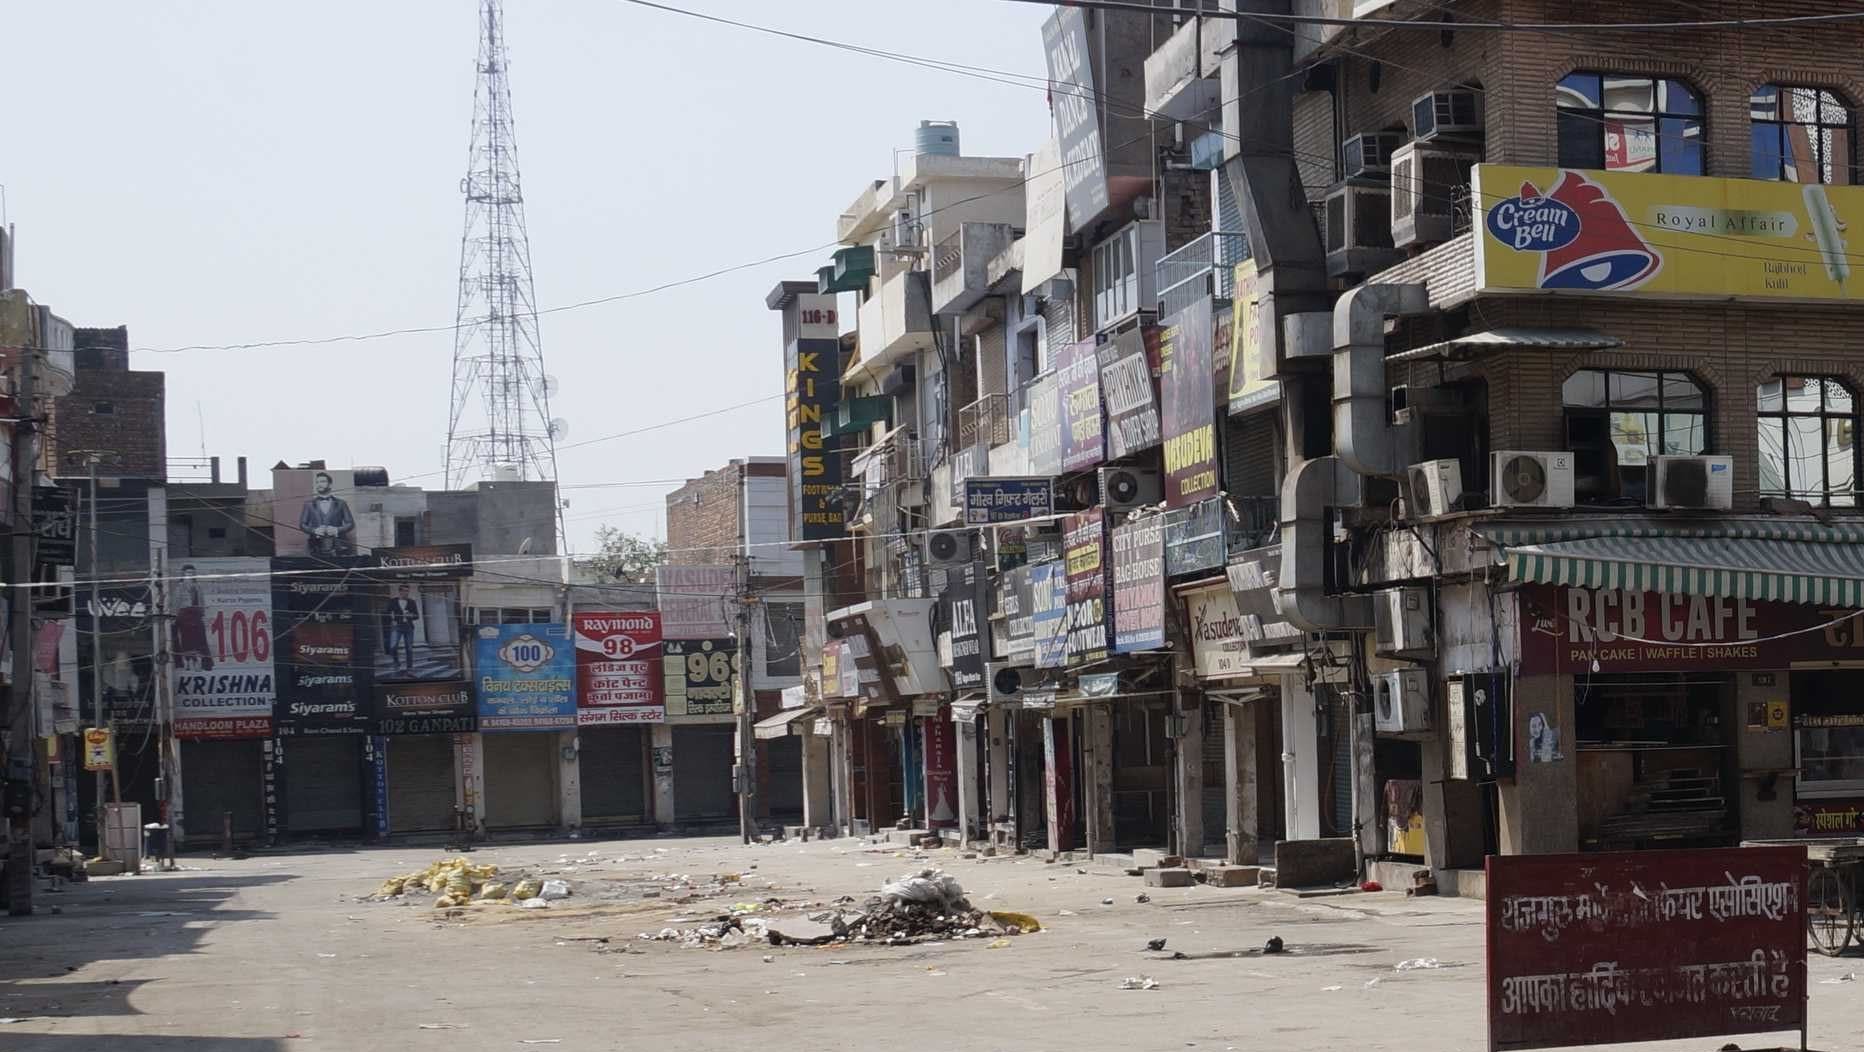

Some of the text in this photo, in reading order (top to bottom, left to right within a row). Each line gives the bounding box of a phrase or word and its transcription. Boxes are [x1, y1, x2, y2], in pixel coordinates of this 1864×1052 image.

[1496, 203, 1568, 231] Cream
[1656, 212, 1786, 233] Royal Affair
[1513, 223, 1555, 250] Bell
[799, 352, 825, 477] KINGS
[1133, 518, 1162, 549] PURSE
[1131, 557, 1161, 582] HOUSE
[583, 616, 654, 634] Raymond
[952, 599, 977, 639] ALFA
[1567, 587, 1759, 643] RCB CAFE
[210, 609, 270, 664] 106
[603, 638, 633, 656] 98
[512, 645, 541, 662] 100
[1570, 646, 1759, 662] PAN CAKE WAFFLE SHAKES
[177, 674, 272, 696] KRISHNA
[182, 697, 267, 708] COLLECTION
[235, 719, 270, 730] PLAZA
[1502, 974, 1567, 1015] आपका
